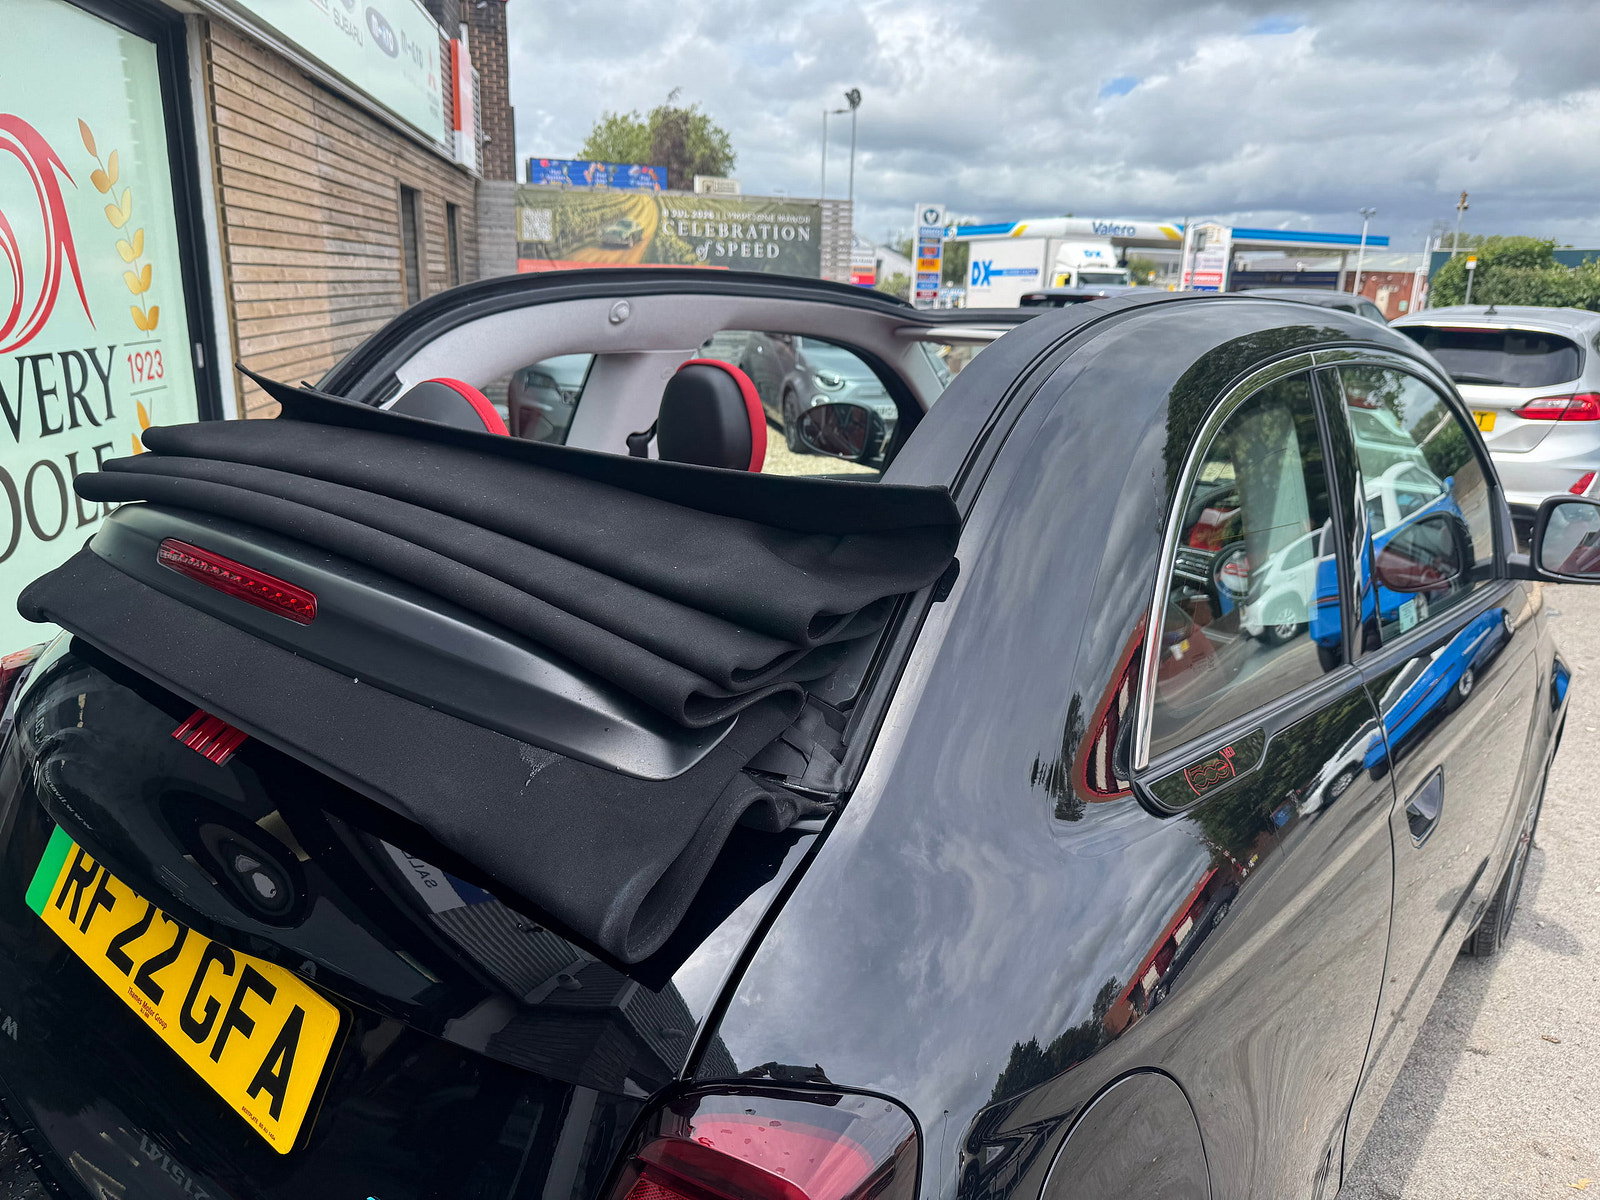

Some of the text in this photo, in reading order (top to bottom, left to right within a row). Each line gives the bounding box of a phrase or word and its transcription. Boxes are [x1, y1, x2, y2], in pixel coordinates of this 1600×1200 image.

[661, 219, 811, 242] CELEBRATION
[1092, 221, 1136, 237] Valero
[695, 239, 780, 261] of SPEED
[971, 261, 992, 286] DX
[126, 349, 164, 384] 1923
[55, 847, 306, 1123] RF22 GFA
[127, 986, 143, 1006] Thames
[142, 1000, 155, 1017] Motor
[154, 1013, 168, 1031] Group
